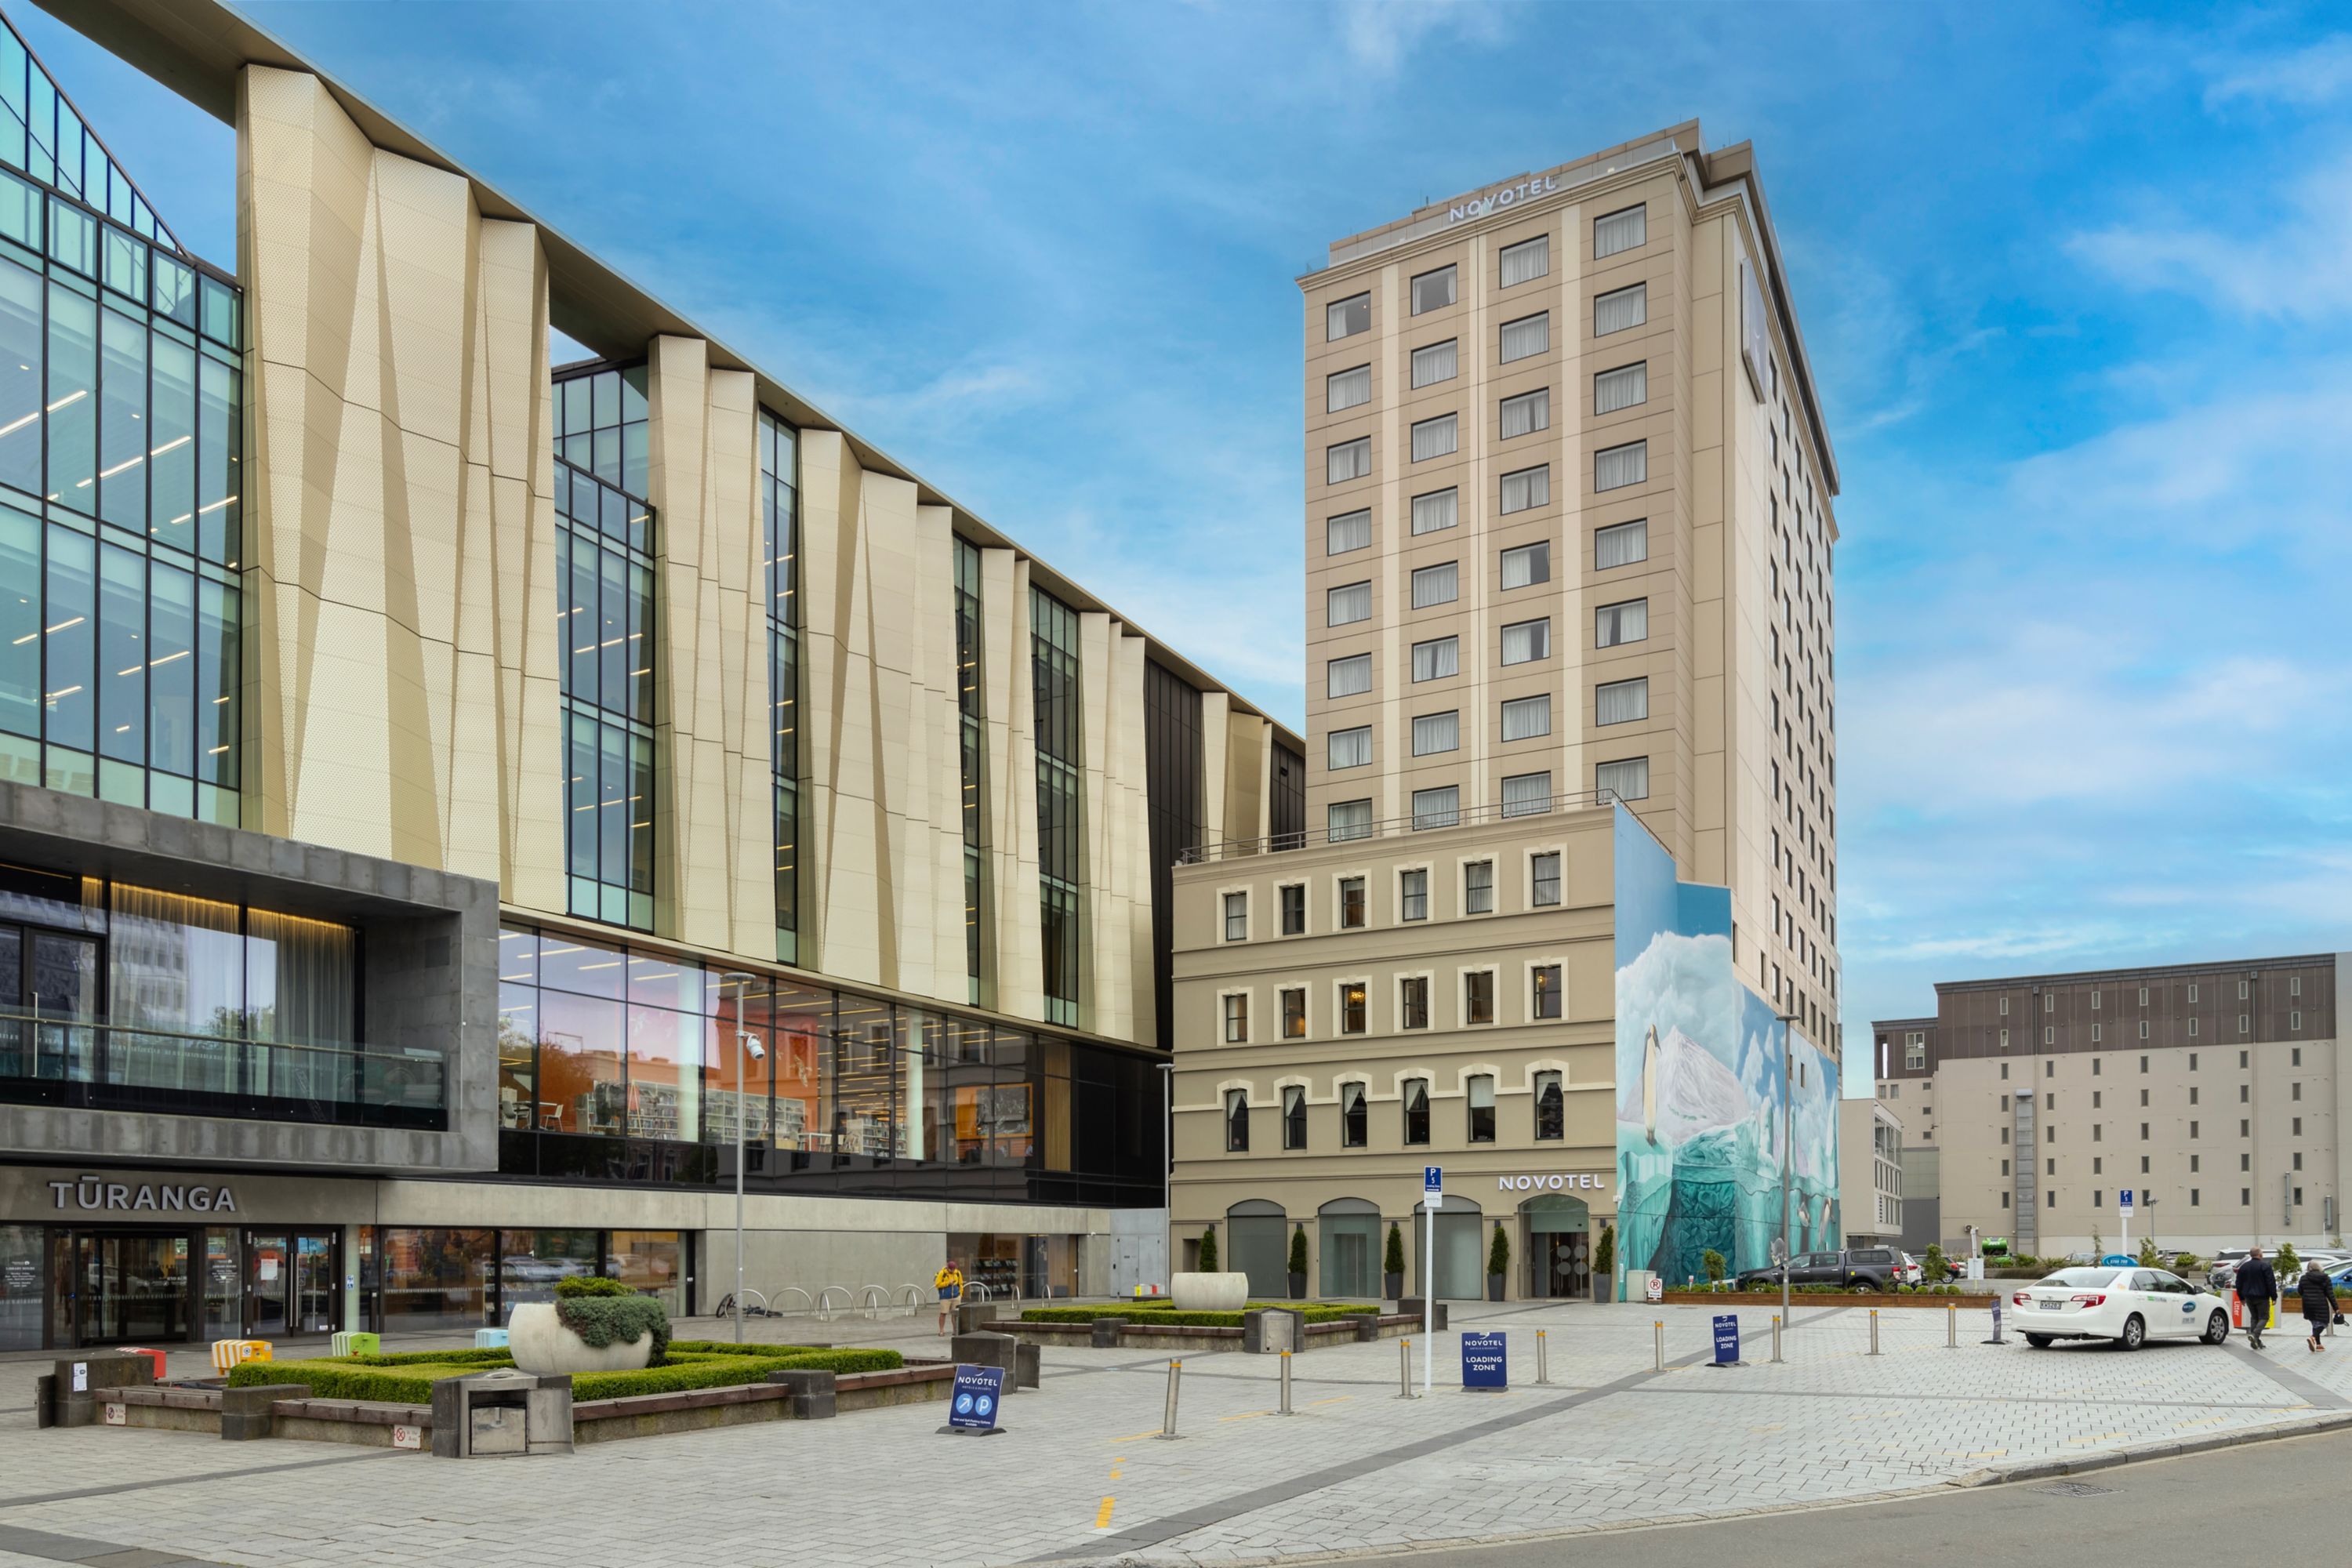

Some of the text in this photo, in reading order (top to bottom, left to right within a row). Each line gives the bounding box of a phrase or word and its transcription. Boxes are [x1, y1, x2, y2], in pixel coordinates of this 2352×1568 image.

[1450, 176, 1556, 222] NOVOTEL
[1499, 1174, 1605, 1190] NOVOTEL
[48, 1175, 235, 1212] TŪRANGA
[958, 1376, 997, 1386] NOVOTEL
[979, 1399, 989, 1412] P
